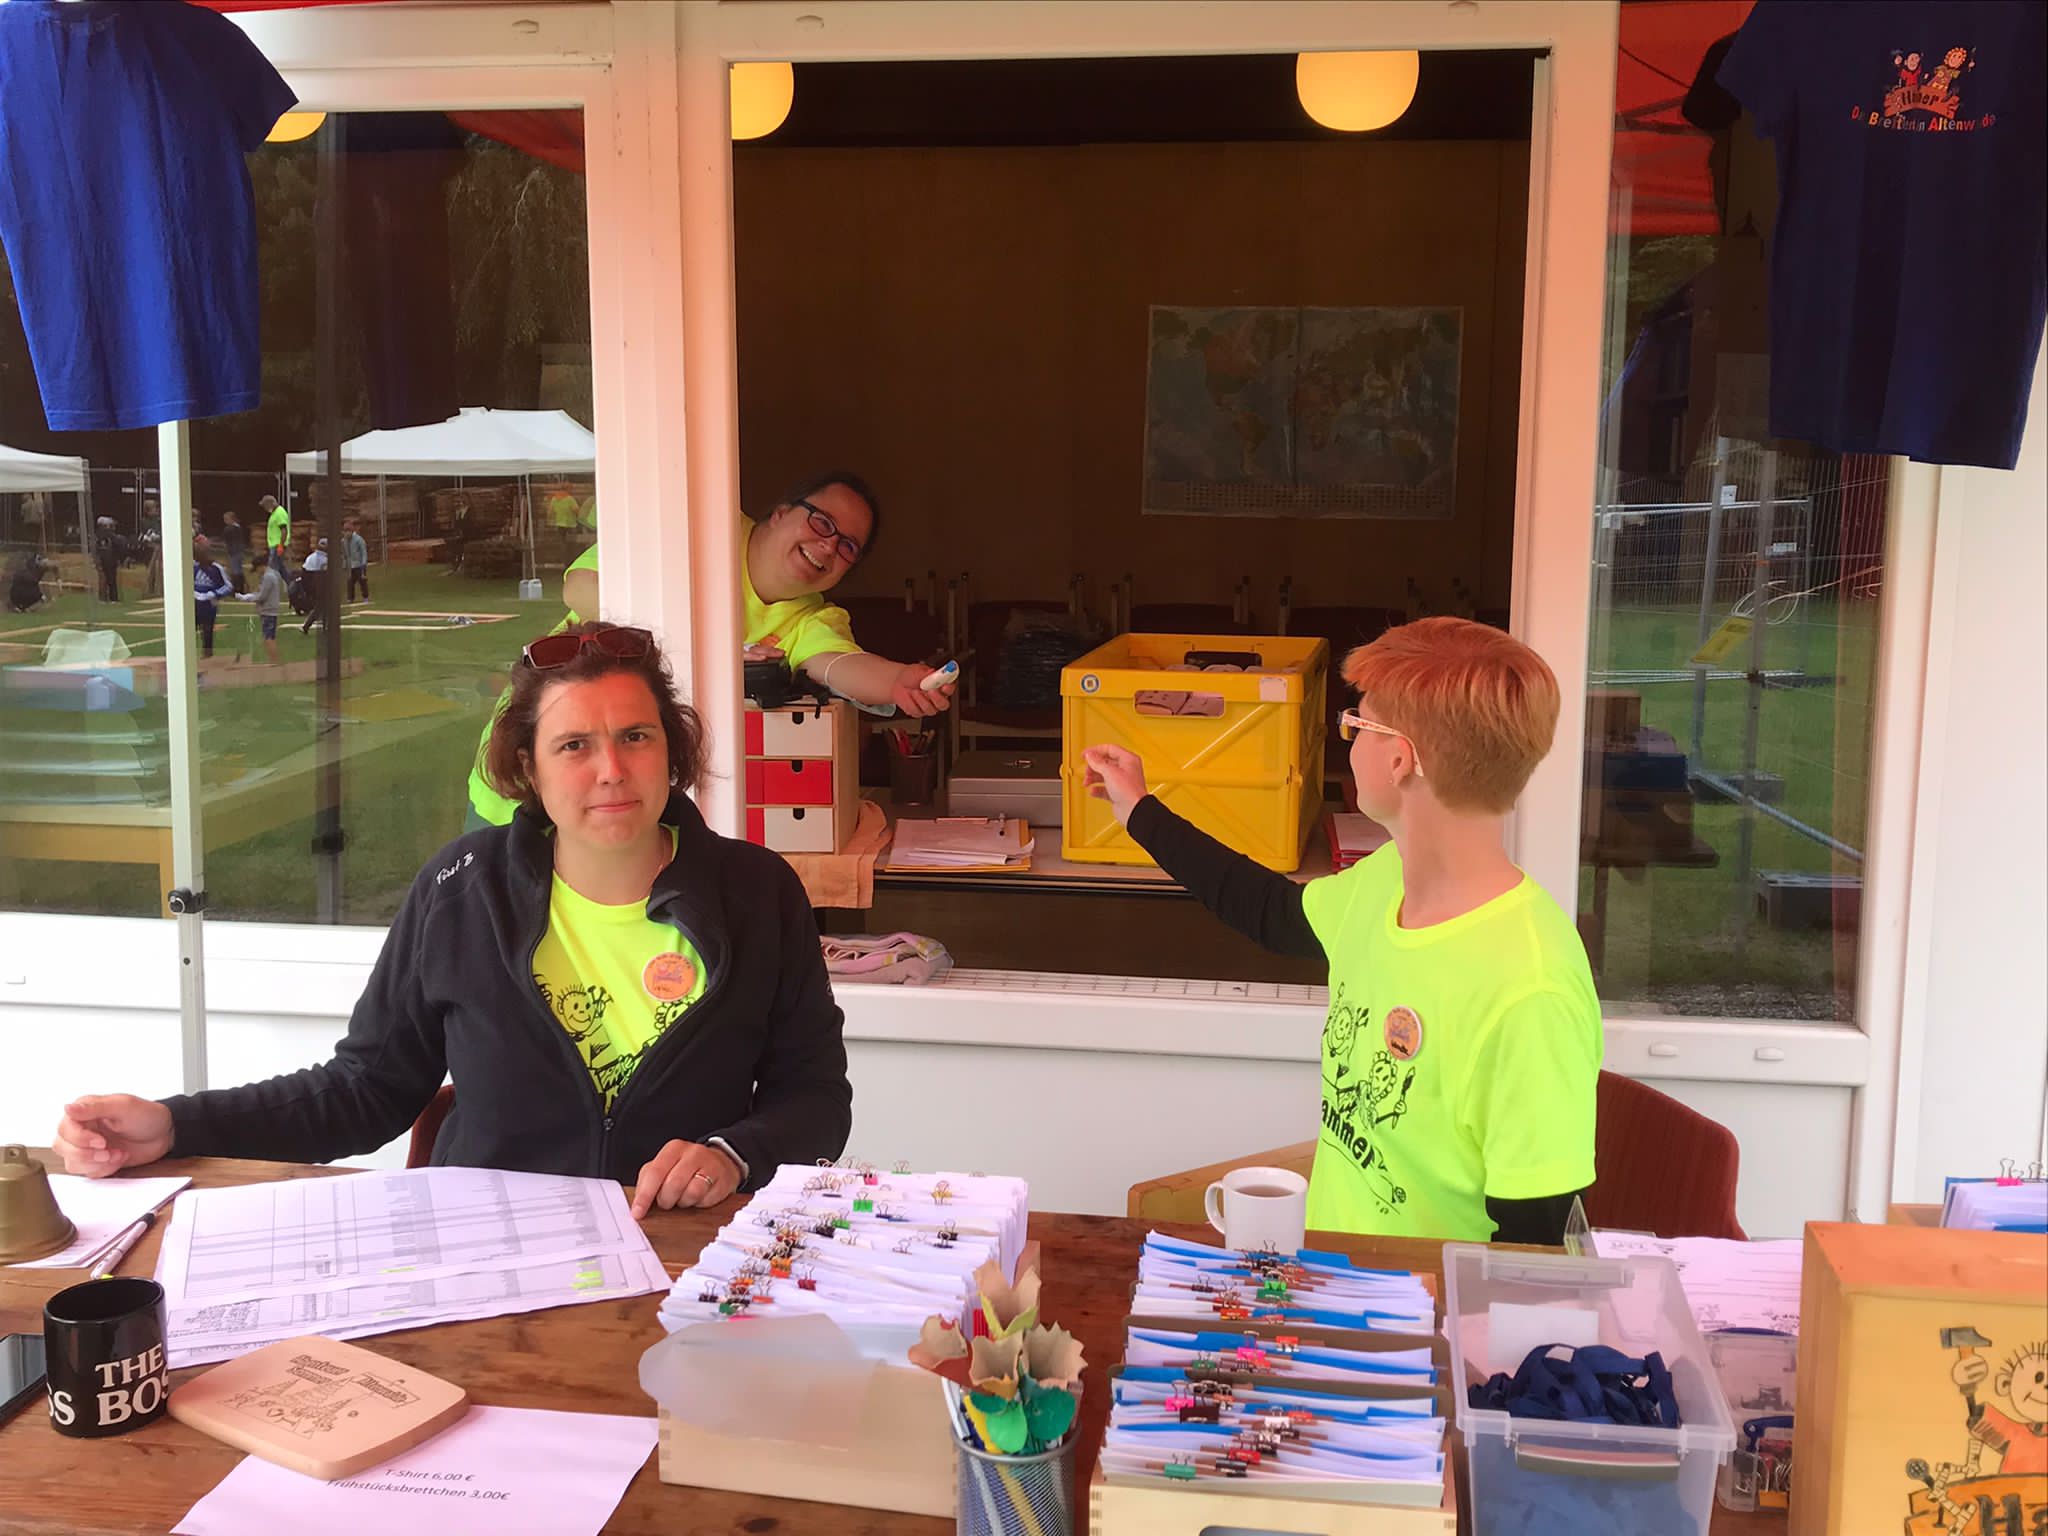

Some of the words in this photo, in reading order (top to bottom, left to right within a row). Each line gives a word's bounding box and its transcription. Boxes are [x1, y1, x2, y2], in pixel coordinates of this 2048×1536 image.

[1321, 1099, 1375, 1169] ammer
[95, 1343, 163, 1388] THE
[96, 1365, 168, 1426] BO
[385, 1469, 429, 1480] T-Shirt
[431, 1472, 463, 1481] 6,00
[464, 1474, 475, 1482] €
[470, 1489, 511, 1501] 3,00€
